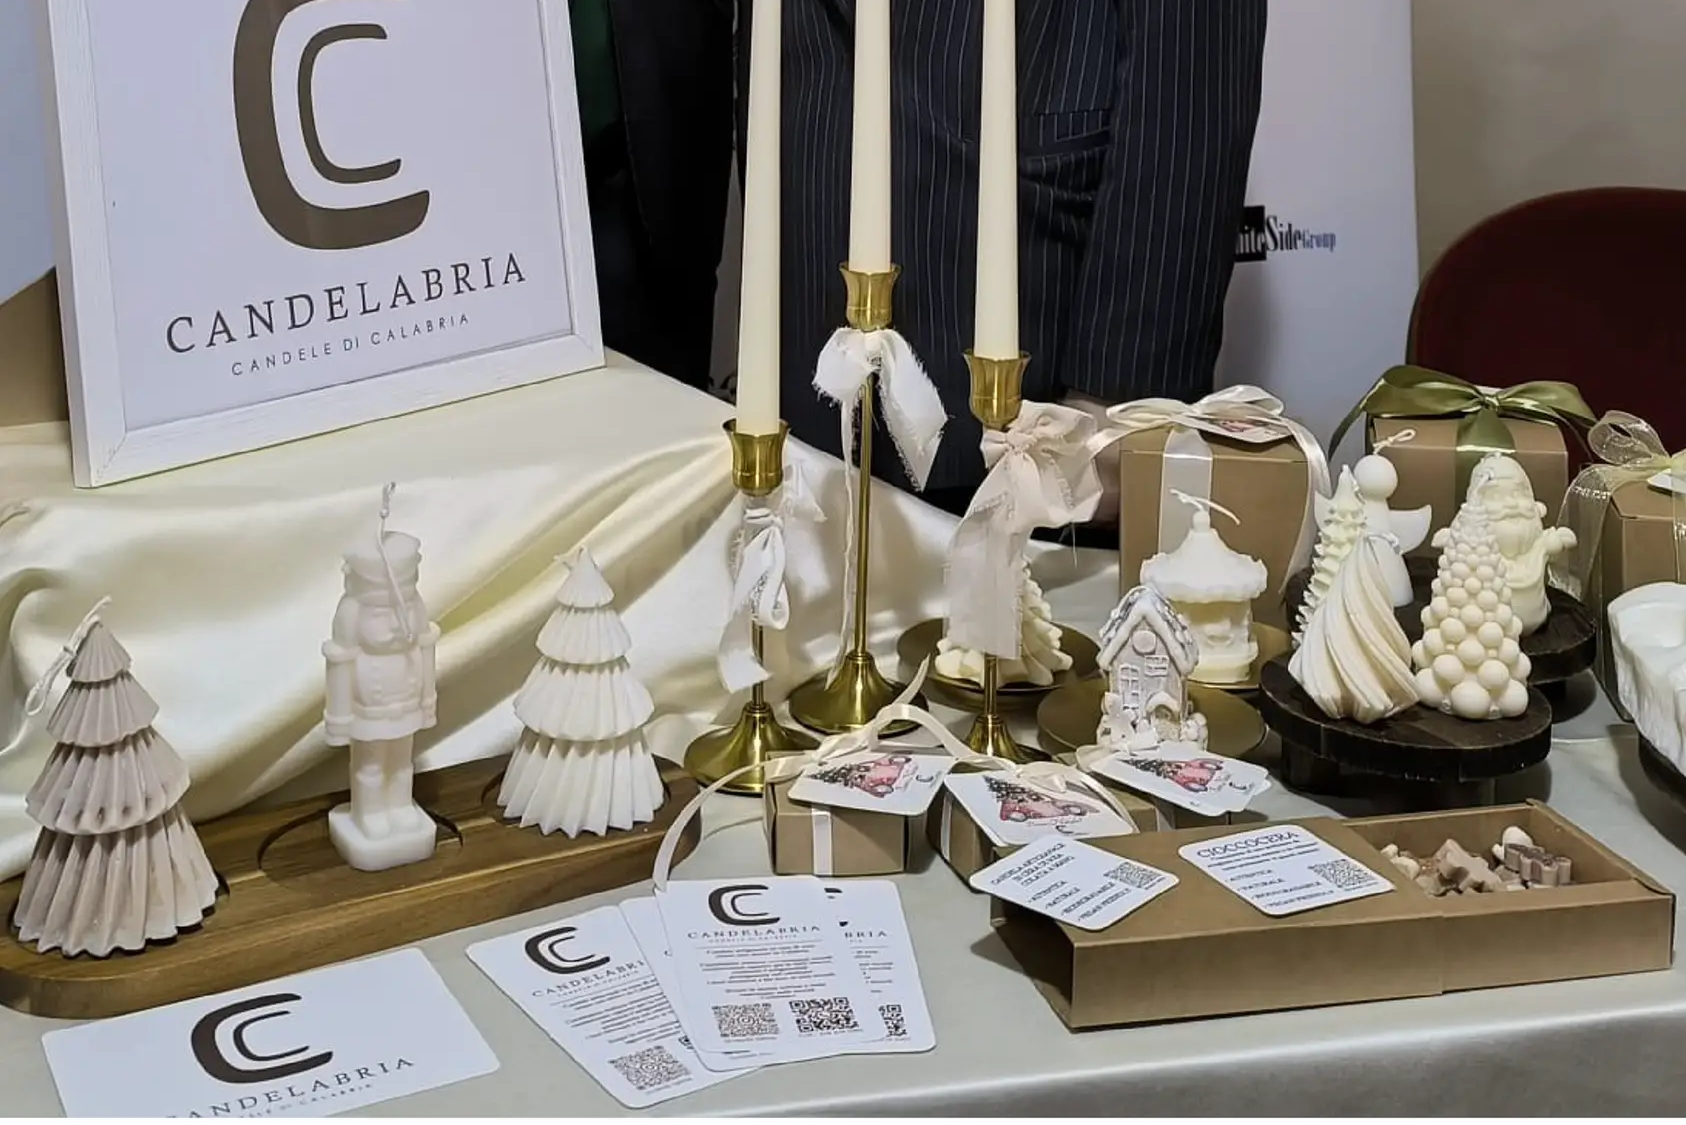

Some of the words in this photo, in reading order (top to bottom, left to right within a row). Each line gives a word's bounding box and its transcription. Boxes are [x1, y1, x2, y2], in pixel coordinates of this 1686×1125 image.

[166, 252, 526, 354] CANDELABRIA
[231, 343, 332, 376] CANDELE
[343, 337, 360, 352] DI
[370, 313, 469, 346] CALABRIA
[166, 1058, 414, 1117] ANDELABRIA
